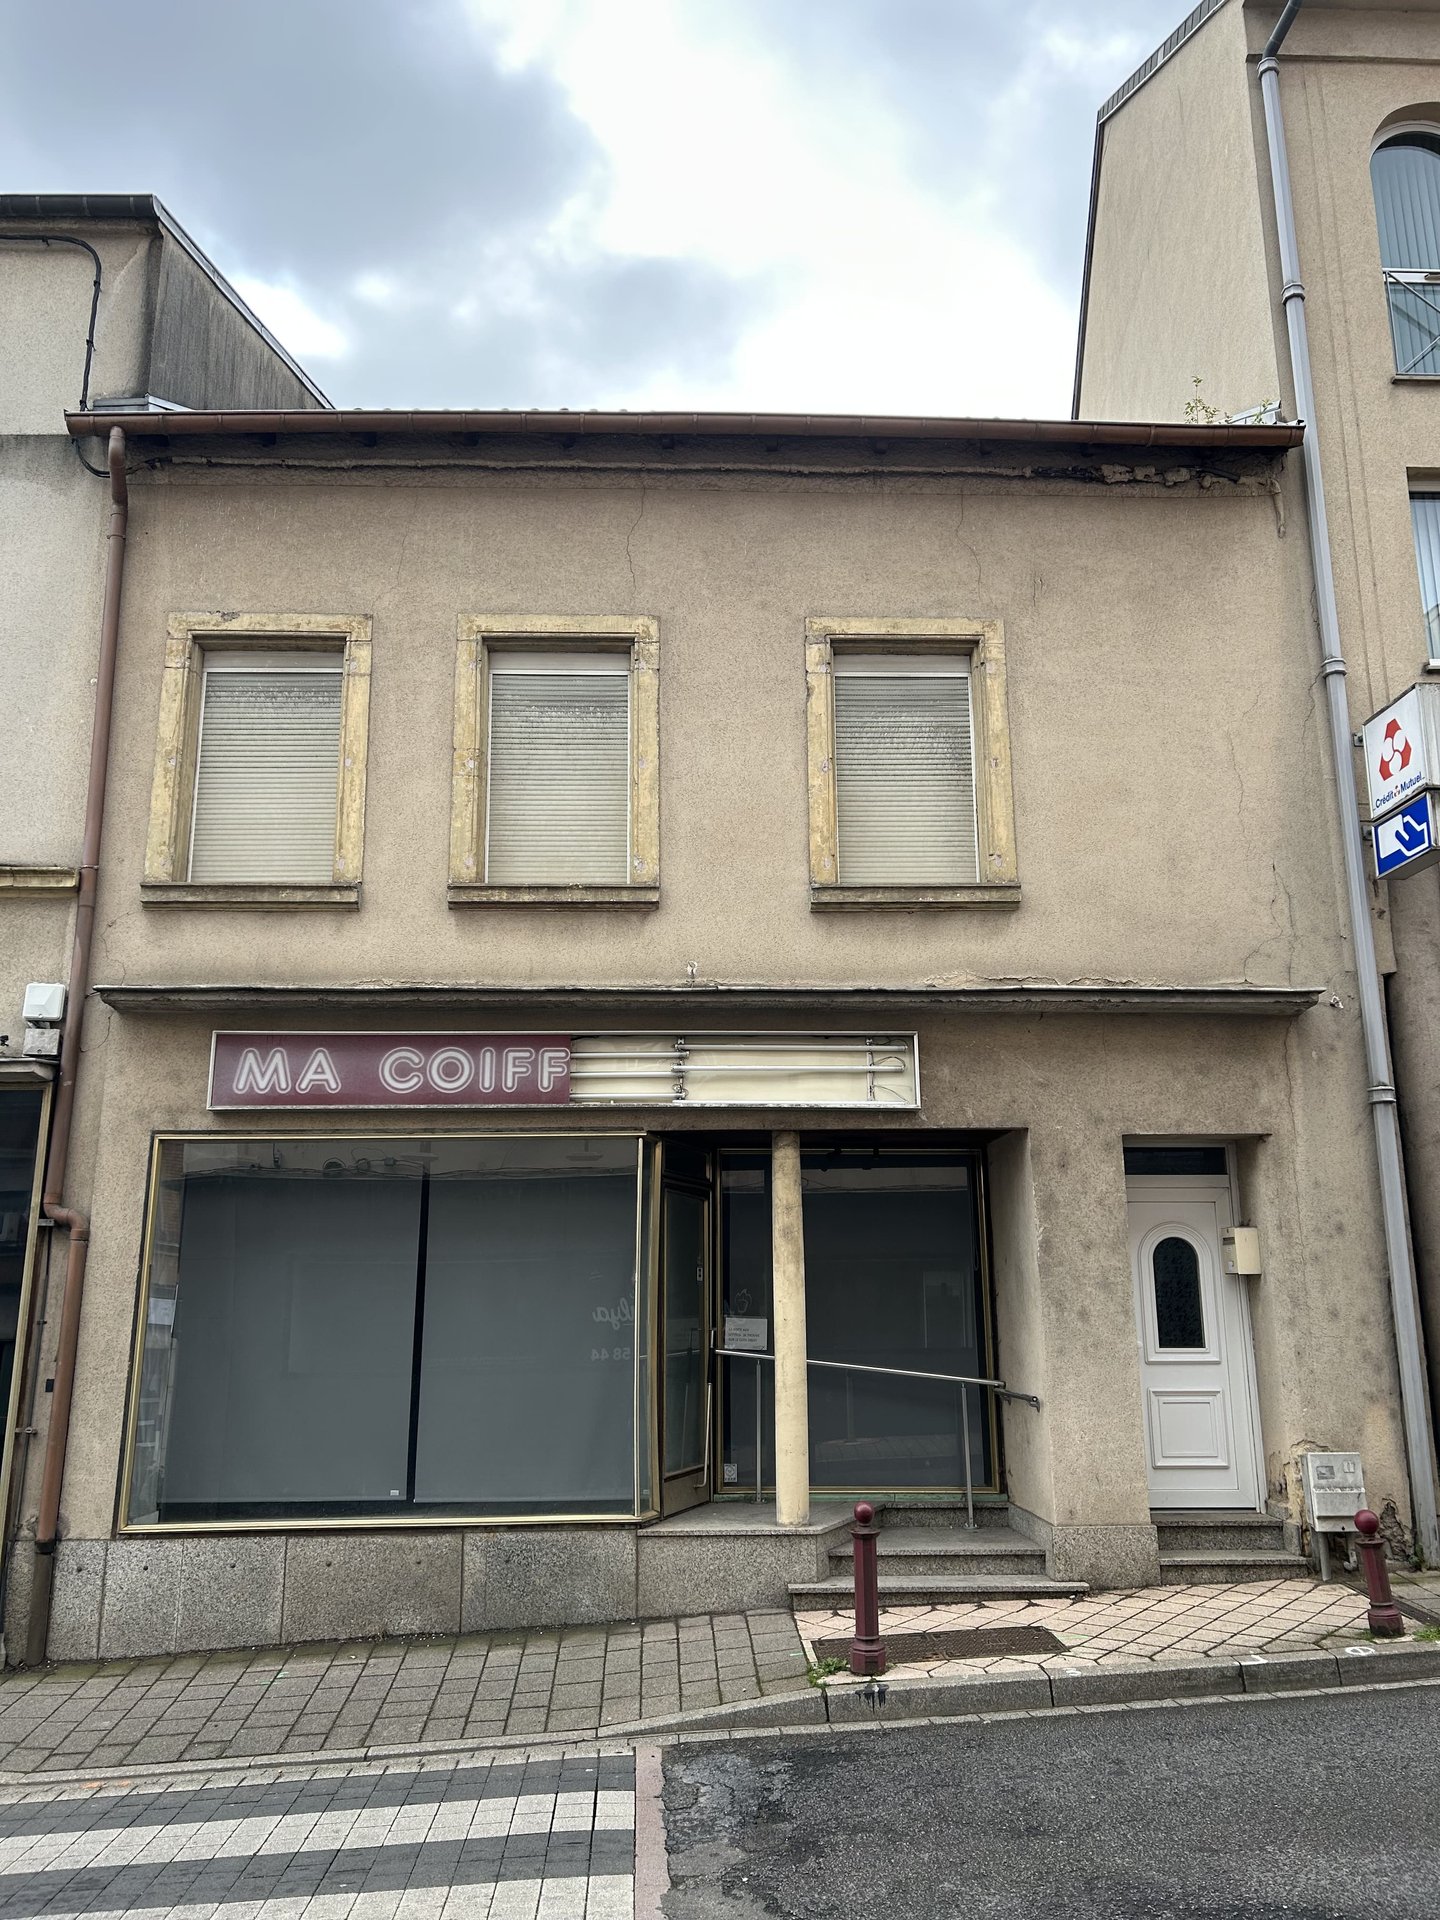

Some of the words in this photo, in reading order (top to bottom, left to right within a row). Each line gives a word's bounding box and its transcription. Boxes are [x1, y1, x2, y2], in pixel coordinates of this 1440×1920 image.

[1375, 790, 1394, 809] Crédit
[1400, 771, 1422, 793] Mutuel
[233, 1047, 341, 1094] MA
[379, 1047, 570, 1094] COIFF
